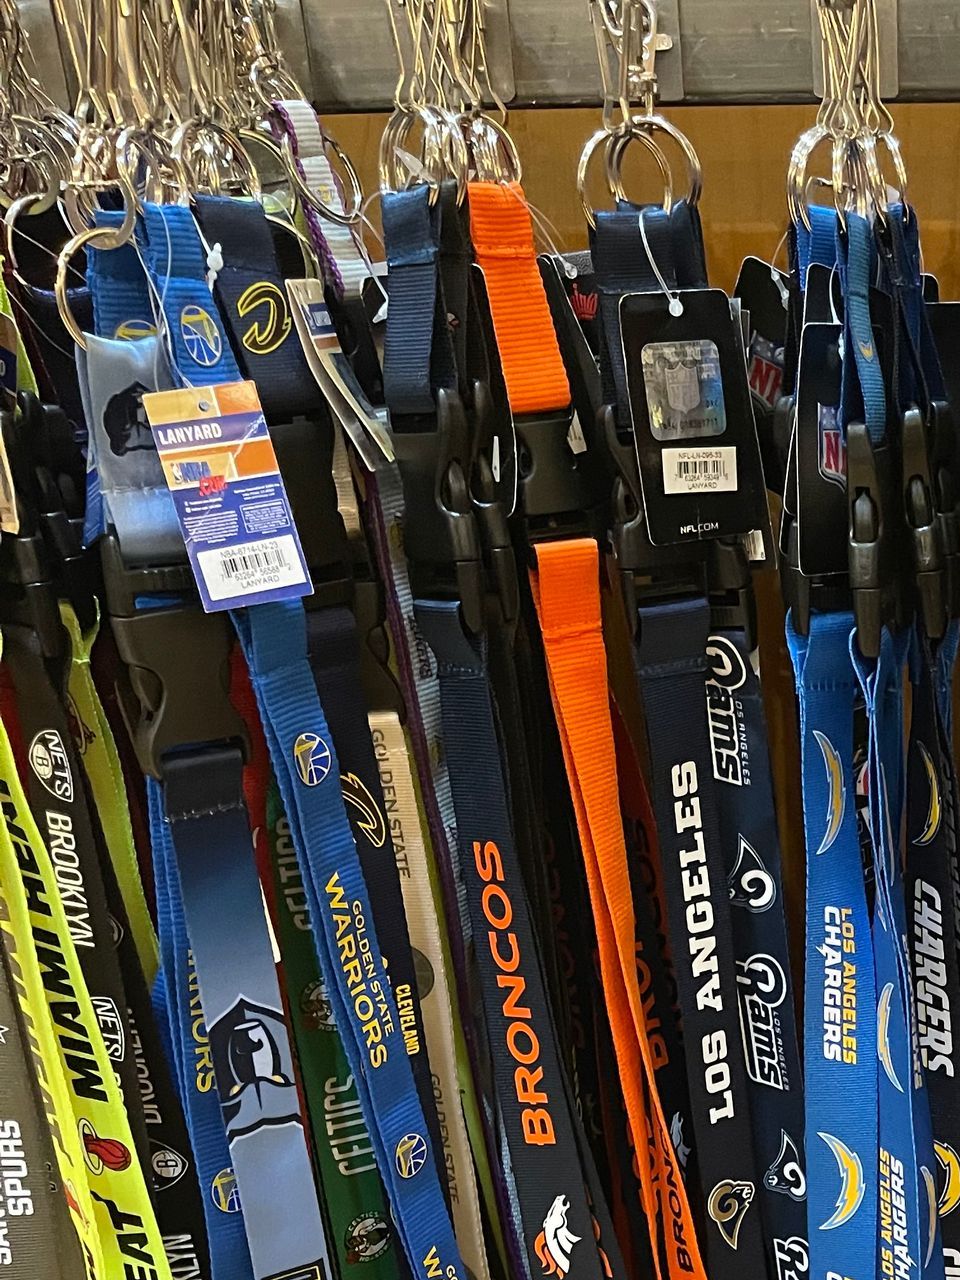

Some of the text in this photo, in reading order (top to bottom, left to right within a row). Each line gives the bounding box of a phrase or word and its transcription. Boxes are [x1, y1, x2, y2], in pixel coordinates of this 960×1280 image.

[157, 423, 222, 446] LANYARD
[687, 482, 718, 491] LANYARD
[240, 574, 280, 590] LANYARD
[44, 733, 71, 801] NETS
[371, 728, 411, 880] GOLDEN STATE
[738, 722, 752, 786] ANGELES
[46, 810, 95, 948] BROOKLYN
[325, 871, 388, 1069] WARRIORS
[352, 900, 394, 1041] GOLDEN STATE
[473, 840, 556, 1146] BRONCOS
[671, 761, 735, 1126] LOS ANGELES
[815, 904, 843, 1063] CHARGERS
[839, 907, 857, 1065] LOS ANGELES
[914, 878, 955, 1078] CHARGERS
[32, 926, 108, 1102] MIAMI
[94, 999, 122, 1061] NETS
[396, 983, 419, 1057] CLEVELAND
[772, 1010, 790, 1091] LOS ANGELES
[1, 1119, 34, 1217] SPURS
[324, 1075, 377, 1177] CELTICS
[442, 1151, 460, 1204] STATE
[879, 1147, 893, 1250] ANGELES
